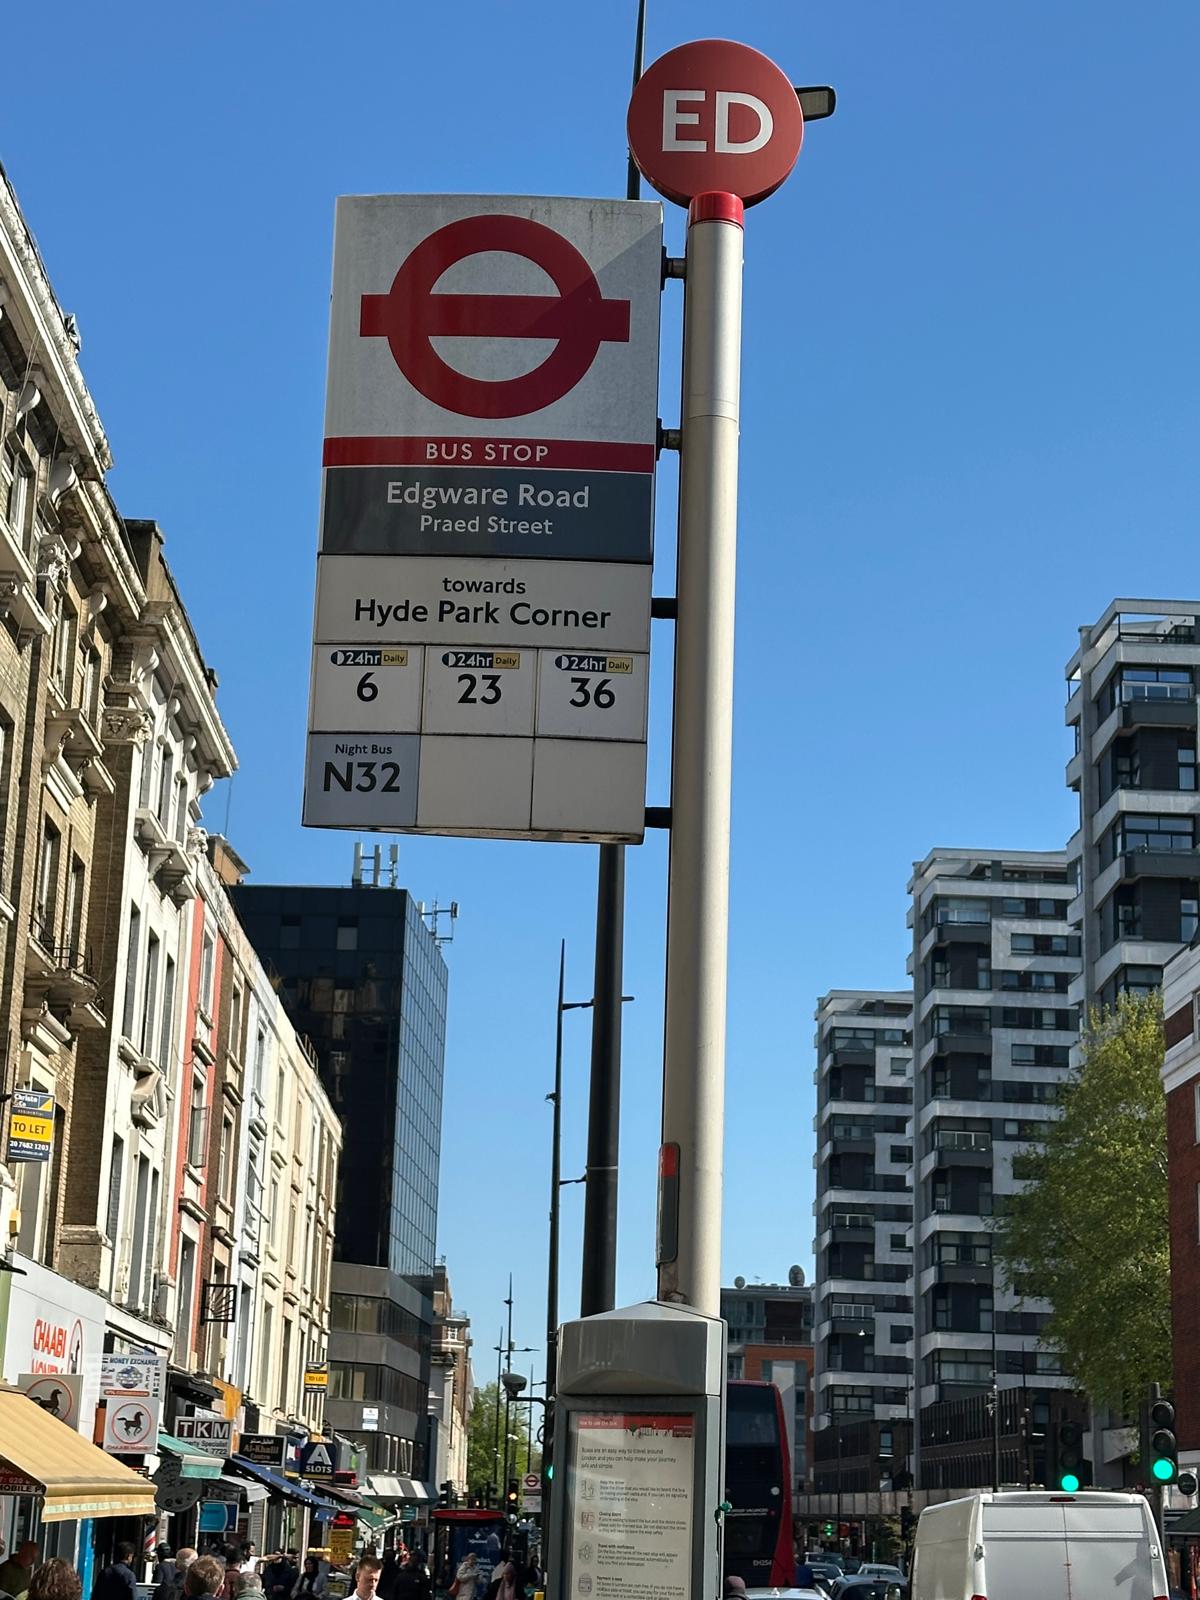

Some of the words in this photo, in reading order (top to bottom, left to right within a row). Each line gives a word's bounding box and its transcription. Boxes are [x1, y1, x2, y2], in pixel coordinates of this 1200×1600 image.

[662, 90, 774, 154] ED
[426, 443, 473, 460] BUS
[485, 444, 549, 462] STOP
[386, 481, 508, 509] Edgware
[519, 484, 590, 508] Road
[420, 515, 479, 533] Praed
[488, 516, 553, 535] Street
[442, 578, 526, 594] towards
[355, 599, 428, 627] Hyde
[438, 600, 500, 625] Park
[510, 602, 611, 629] Corner
[345, 652, 380, 665] 24hr
[383, 652, 406, 664] Daily
[457, 653, 492, 668] 24hr
[495, 655, 517, 667] Daily
[570, 656, 605, 671] 24hr
[608, 659, 630, 672] Daily
[356, 672, 379, 702] 6
[457, 674, 502, 705] 23
[570, 678, 616, 709] 36
[335, 743, 368, 756] Night
[370, 743, 392, 755] Bus
[323, 761, 401, 793] N32
[14, 1122, 26, 1132] TO
[29, 1124, 46, 1135] LET
[33, 1318, 67, 1358] CHAABI
[180, 1421, 229, 1438] TKM
[307, 1444, 332, 1465] A
[306, 1465, 332, 1473] SLOTS
